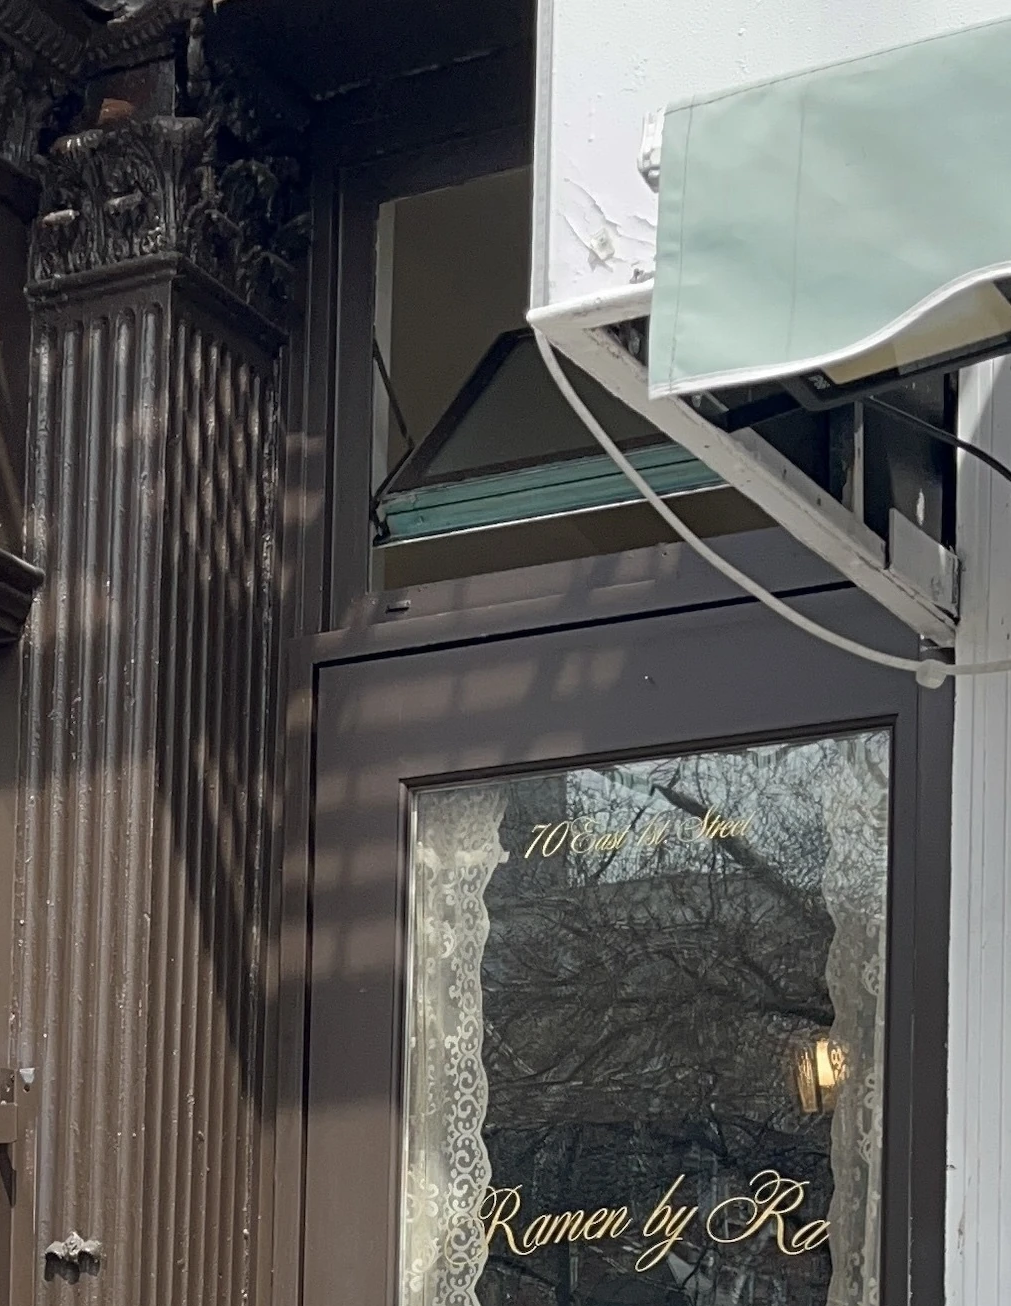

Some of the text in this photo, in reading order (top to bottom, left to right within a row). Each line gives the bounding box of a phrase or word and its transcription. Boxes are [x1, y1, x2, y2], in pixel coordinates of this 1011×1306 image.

[524, 820, 570, 859] 70
[570, 815, 632, 854] East
[676, 804, 757, 843] Street
[446, 1169, 830, 1273] Ramen by Ra
